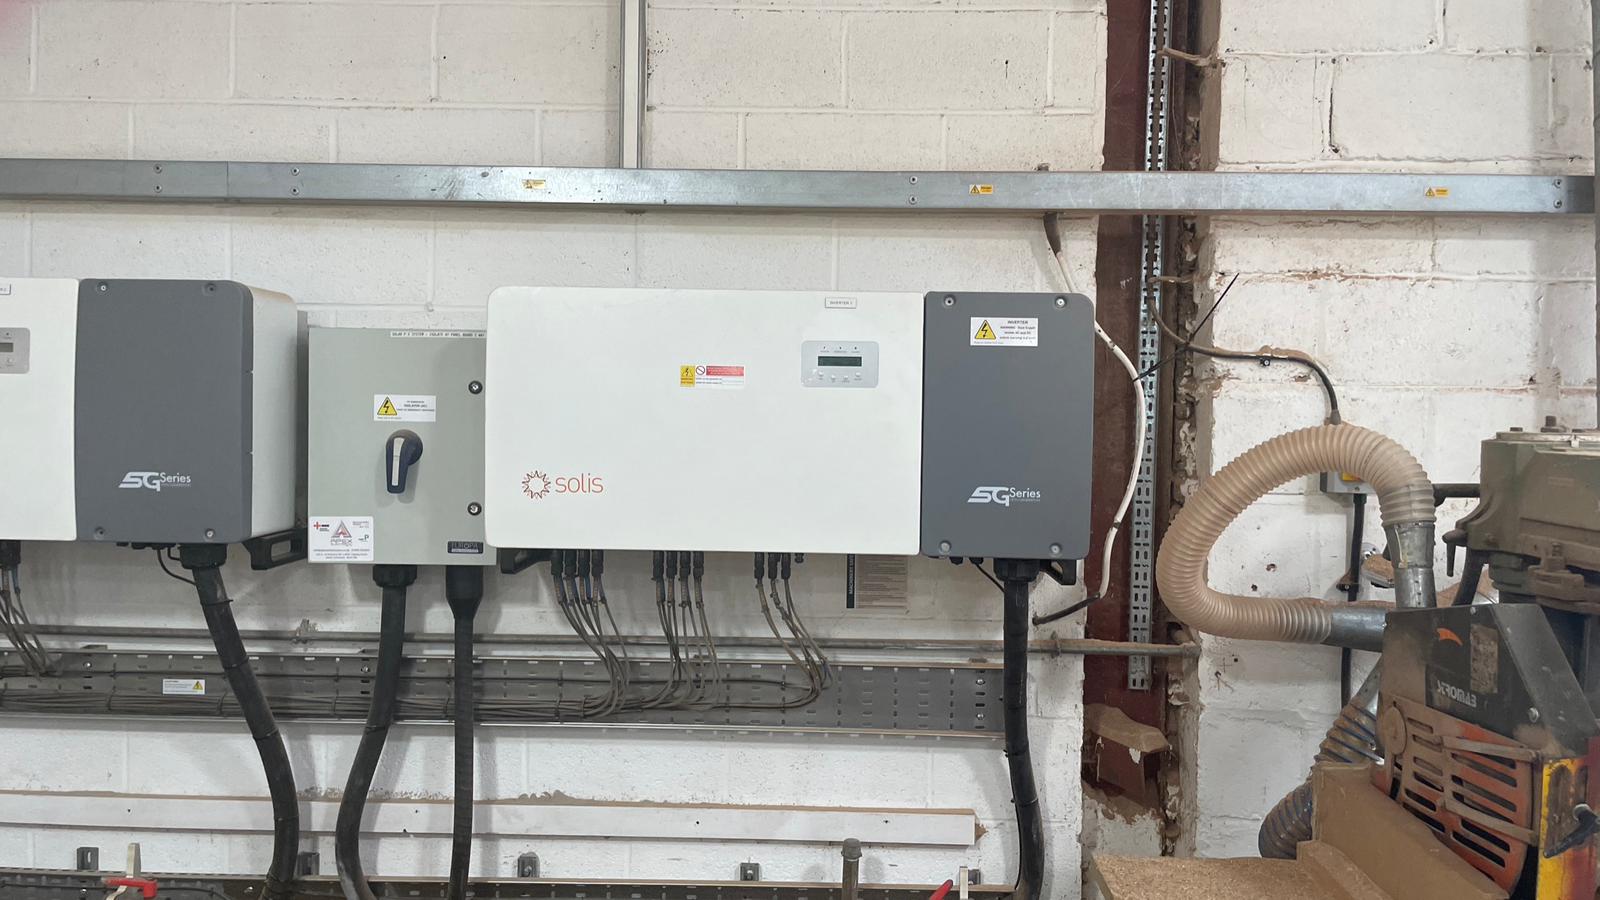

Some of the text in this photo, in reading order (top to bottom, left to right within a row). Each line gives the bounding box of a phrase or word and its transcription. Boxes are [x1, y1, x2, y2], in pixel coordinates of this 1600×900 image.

[160, 471, 192, 483] Series
[555, 472, 604, 494] solis
[1009, 487, 1041, 498] Series
